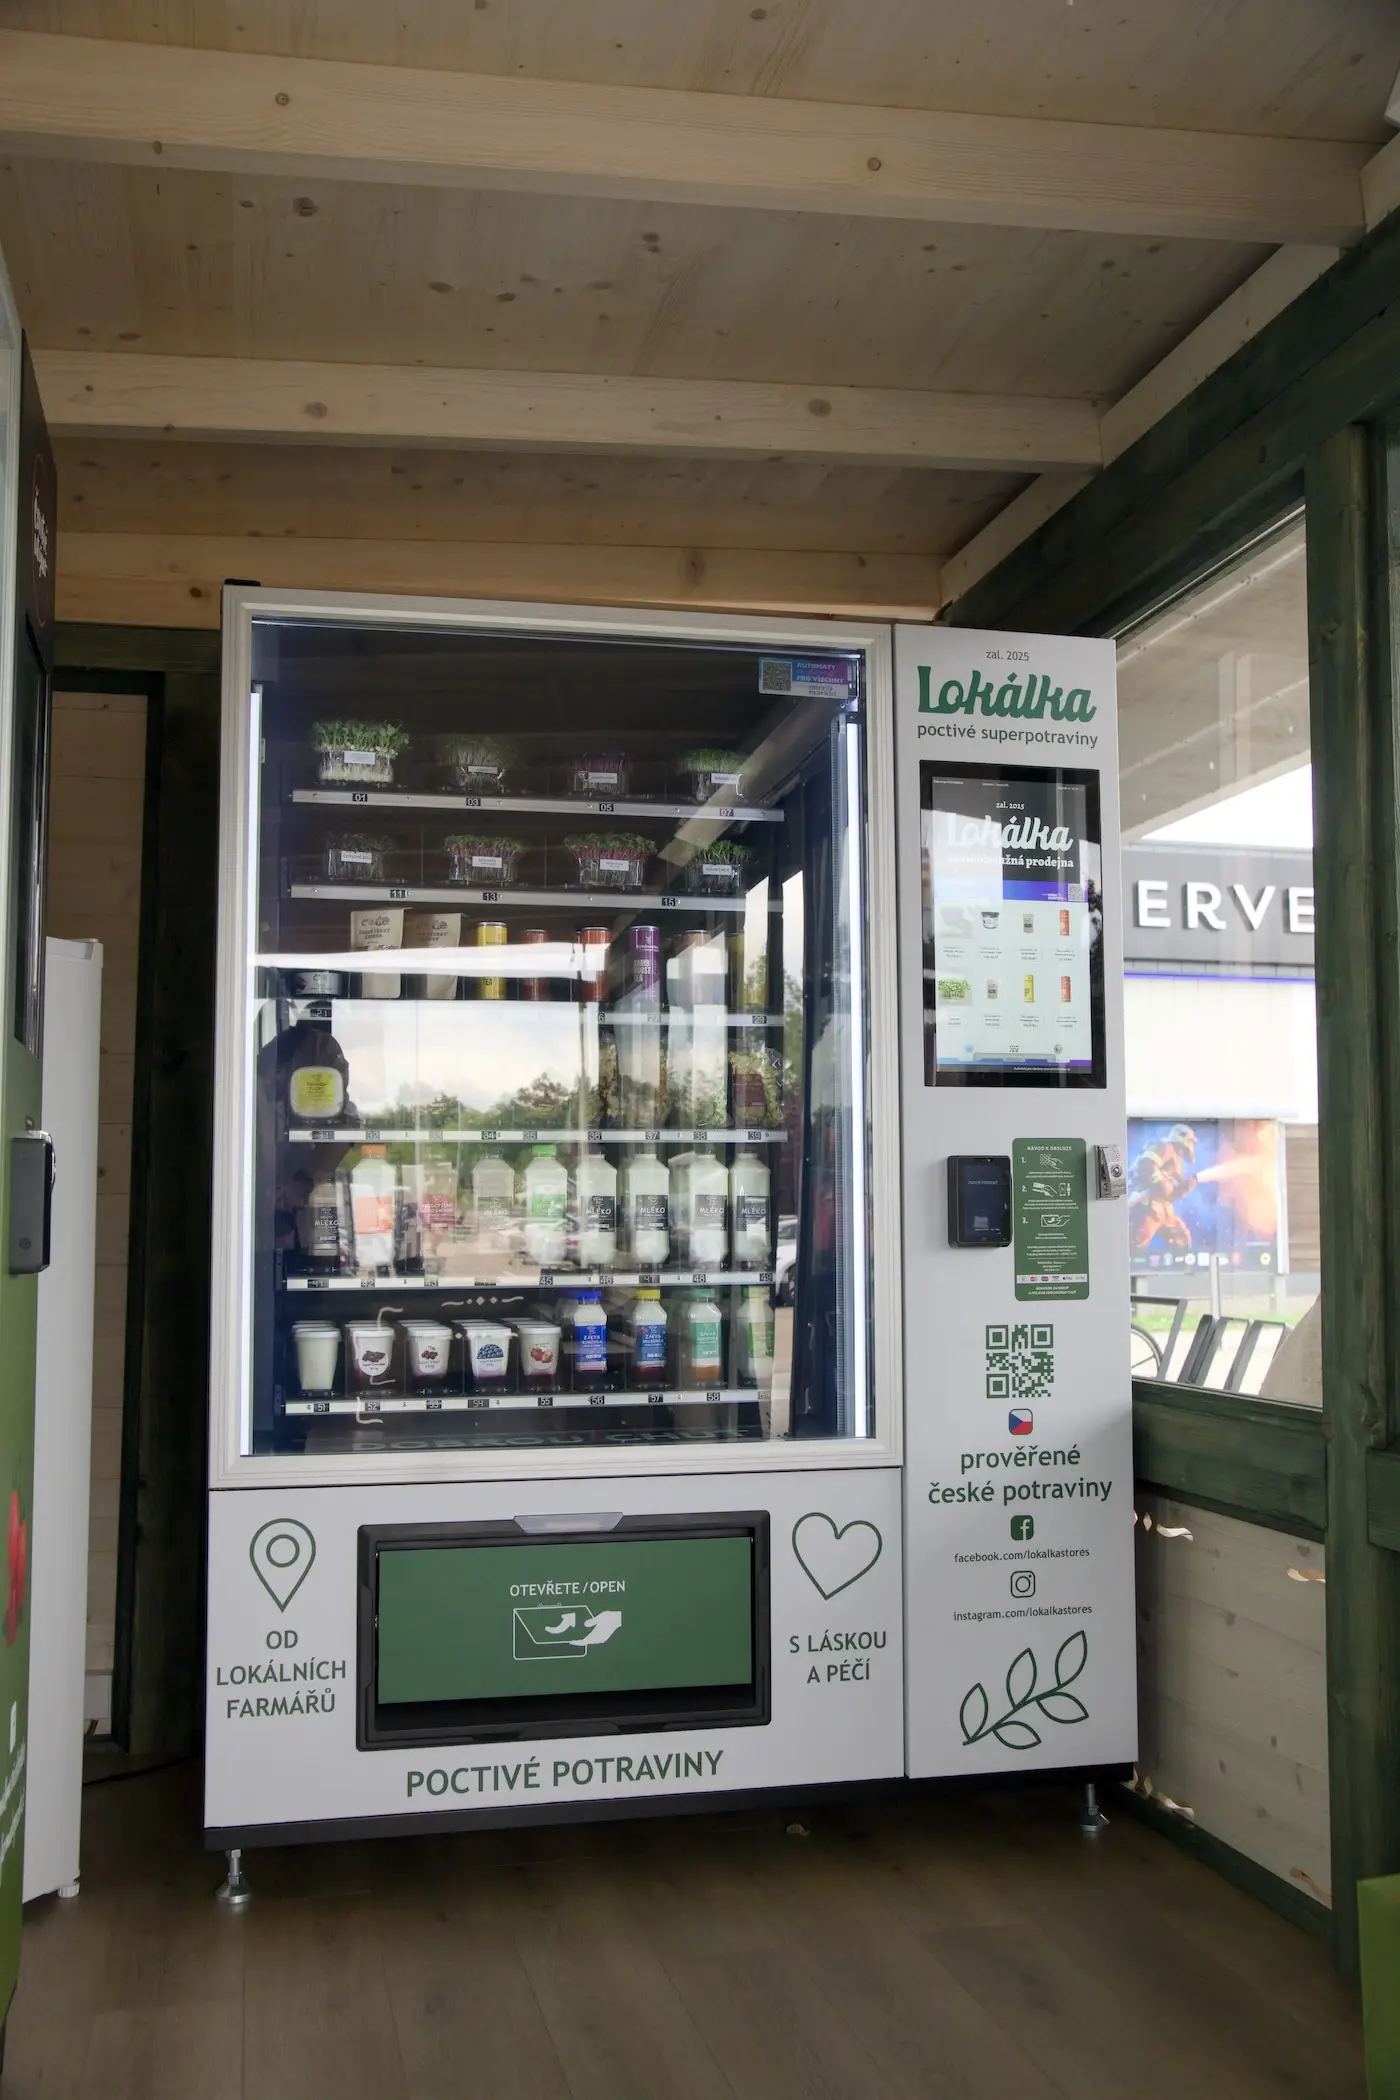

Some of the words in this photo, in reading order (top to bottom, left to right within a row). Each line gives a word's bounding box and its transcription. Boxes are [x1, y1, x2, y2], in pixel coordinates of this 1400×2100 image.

[986, 650, 1003, 660] zal.
[1007, 651, 1029, 662] 2025
[918, 665, 1097, 722] Lokálka
[918, 724, 976, 739] poctivé
[982, 727, 1098, 748] superpotraviny
[355, 794, 366, 802] 01
[468, 798, 479, 806] 03
[600, 804, 612, 812] 05
[721, 808, 732, 816] 07
[1026, 856, 1074, 870] prodejna
[485, 892, 496, 900] 13
[754, 1016, 764, 1024] 29
[368, 1132, 378, 1140] 32
[482, 1132, 494, 1140] 34
[524, 1132, 536, 1140] 35
[590, 1132, 600, 1140] 36
[695, 1132, 706, 1140] 38
[750, 1132, 760, 1140] 39
[586, 1206, 612, 1215] MLÉKO
[640, 1205, 666, 1214] MLÉKO
[700, 1205, 724, 1214] MLÉKO
[740, 1206, 766, 1214] MLÉKO
[540, 1276, 552, 1284] 45
[601, 1276, 612, 1284] 46
[694, 1275, 706, 1283] 48
[960, 1444, 1080, 1474] prověřené
[928, 1481, 994, 1504] české
[1004, 1477, 1112, 1506] potraviny
[954, 1548, 1090, 1563] facebook.com/lokalkastores
[510, 1580, 580, 1596] OTEVŘETE
[954, 1604, 1092, 1622] instagram.com/lokalkastores
[266, 1630, 298, 1650] OD
[790, 1636, 800, 1654] S
[808, 1629, 886, 1652] LÁSKOU
[216, 1656, 346, 1686] LOKÁLNÍCH
[806, 1666, 820, 1684] A
[827, 1658, 870, 1682] PÉČÍ
[226, 1688, 336, 1718] FARMÁŘŮ
[406, 1756, 540, 1797] POCTIVÉ
[552, 1750, 724, 1787] POTRAVINY
